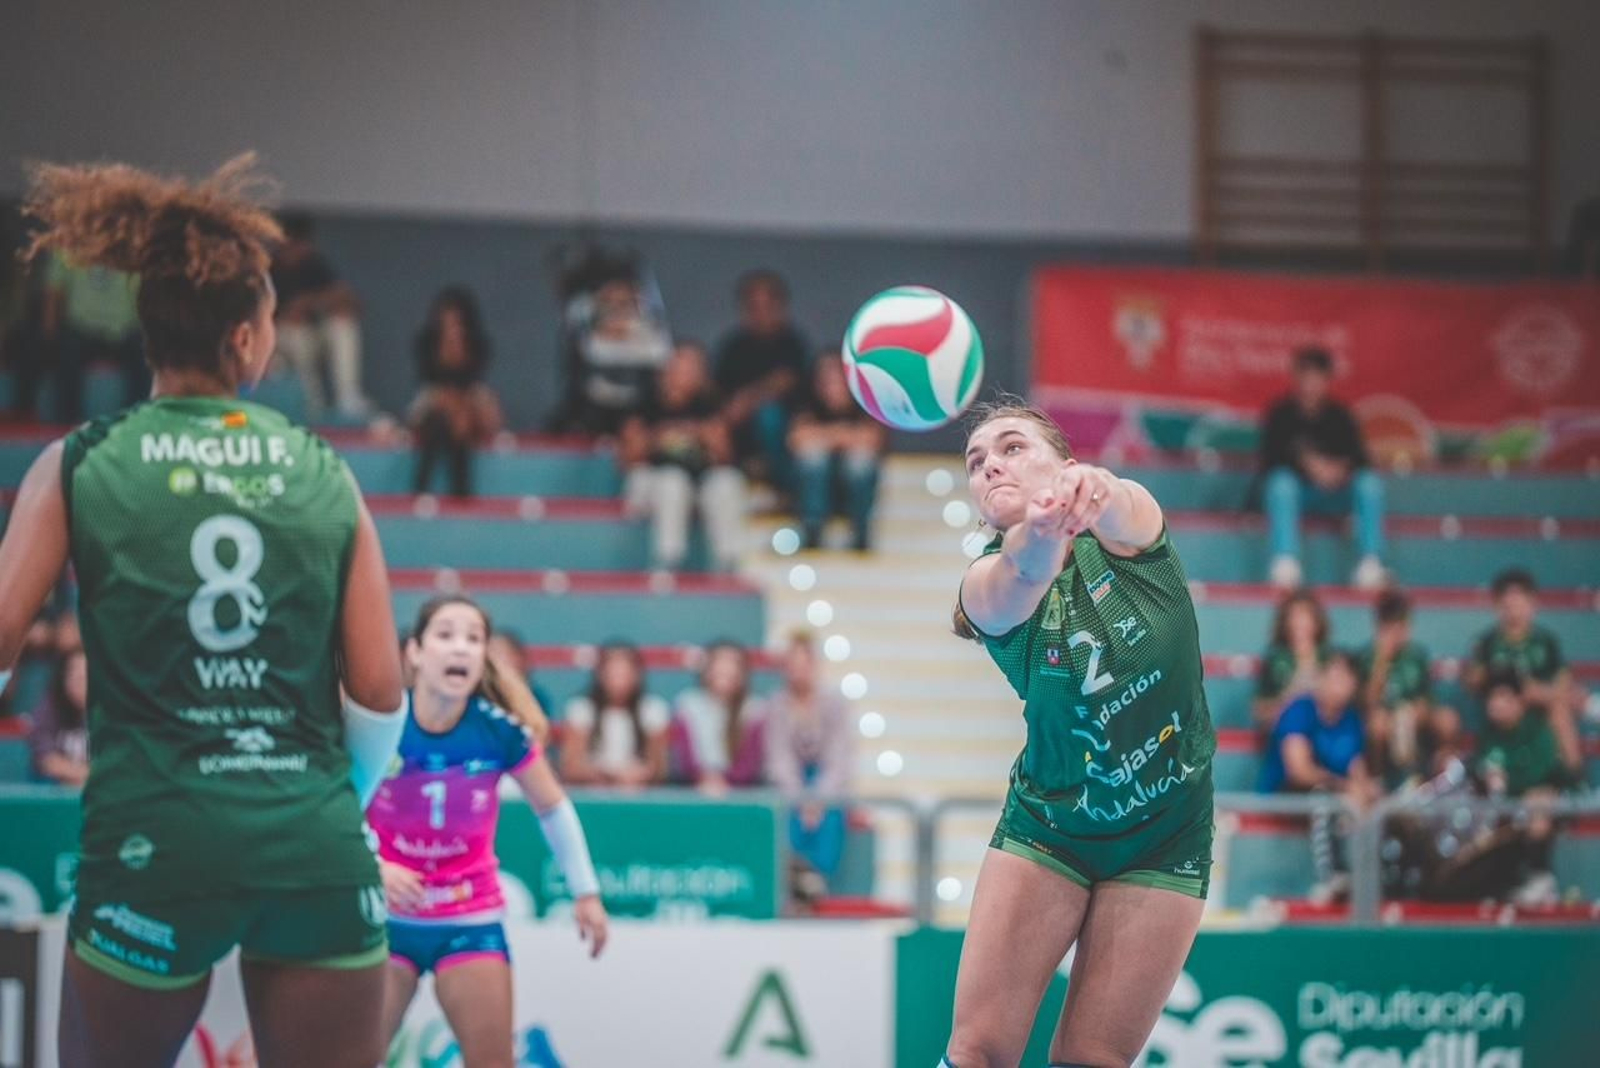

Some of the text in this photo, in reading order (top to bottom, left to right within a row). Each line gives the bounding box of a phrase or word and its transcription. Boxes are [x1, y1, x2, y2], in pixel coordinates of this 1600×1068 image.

[140, 432, 295, 467] MAGUI F.
[187, 514, 268, 652] 8
[194, 656, 269, 690] WAY
[1067, 629, 1115, 696] 2
[421, 780, 447, 830] 1
[1297, 981, 1526, 1031] Diputación
